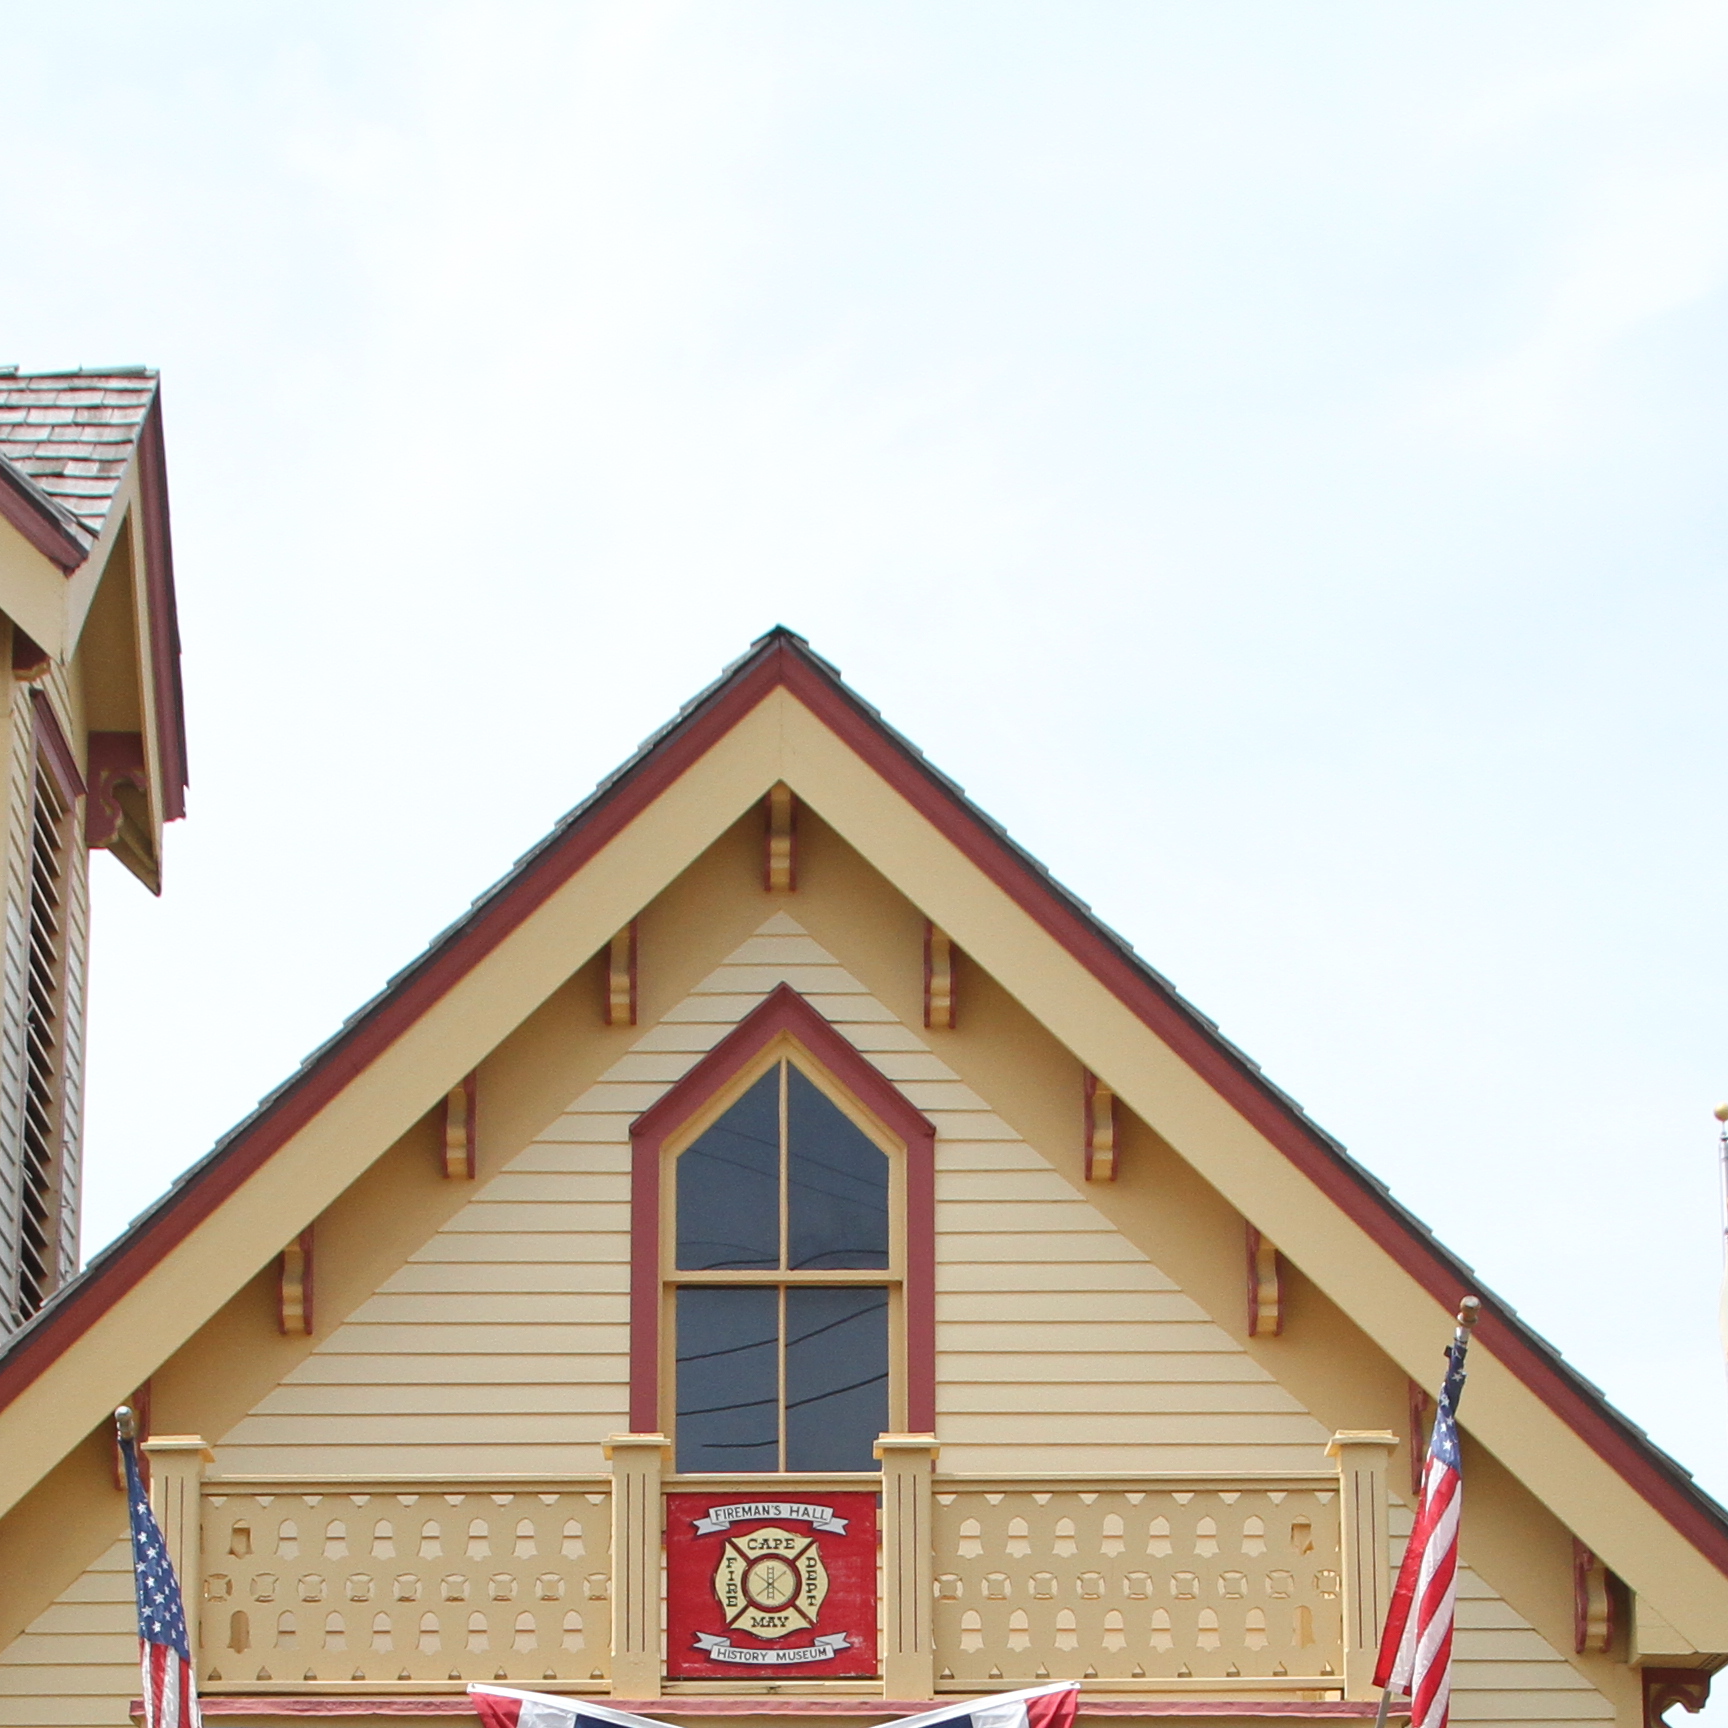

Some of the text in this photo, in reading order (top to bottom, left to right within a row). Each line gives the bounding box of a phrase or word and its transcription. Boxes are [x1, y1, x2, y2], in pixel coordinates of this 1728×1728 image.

[714, 1505, 828, 1521] FIREMAN'S HALL
[747, 1538, 795, 1550] CAPE
[725, 1557, 738, 1607] FIRE
[805, 1556, 818, 1606] DEPT
[750, 1616, 790, 1628] MAY
[717, 1647, 828, 1662] HISTORY MUSEUM
